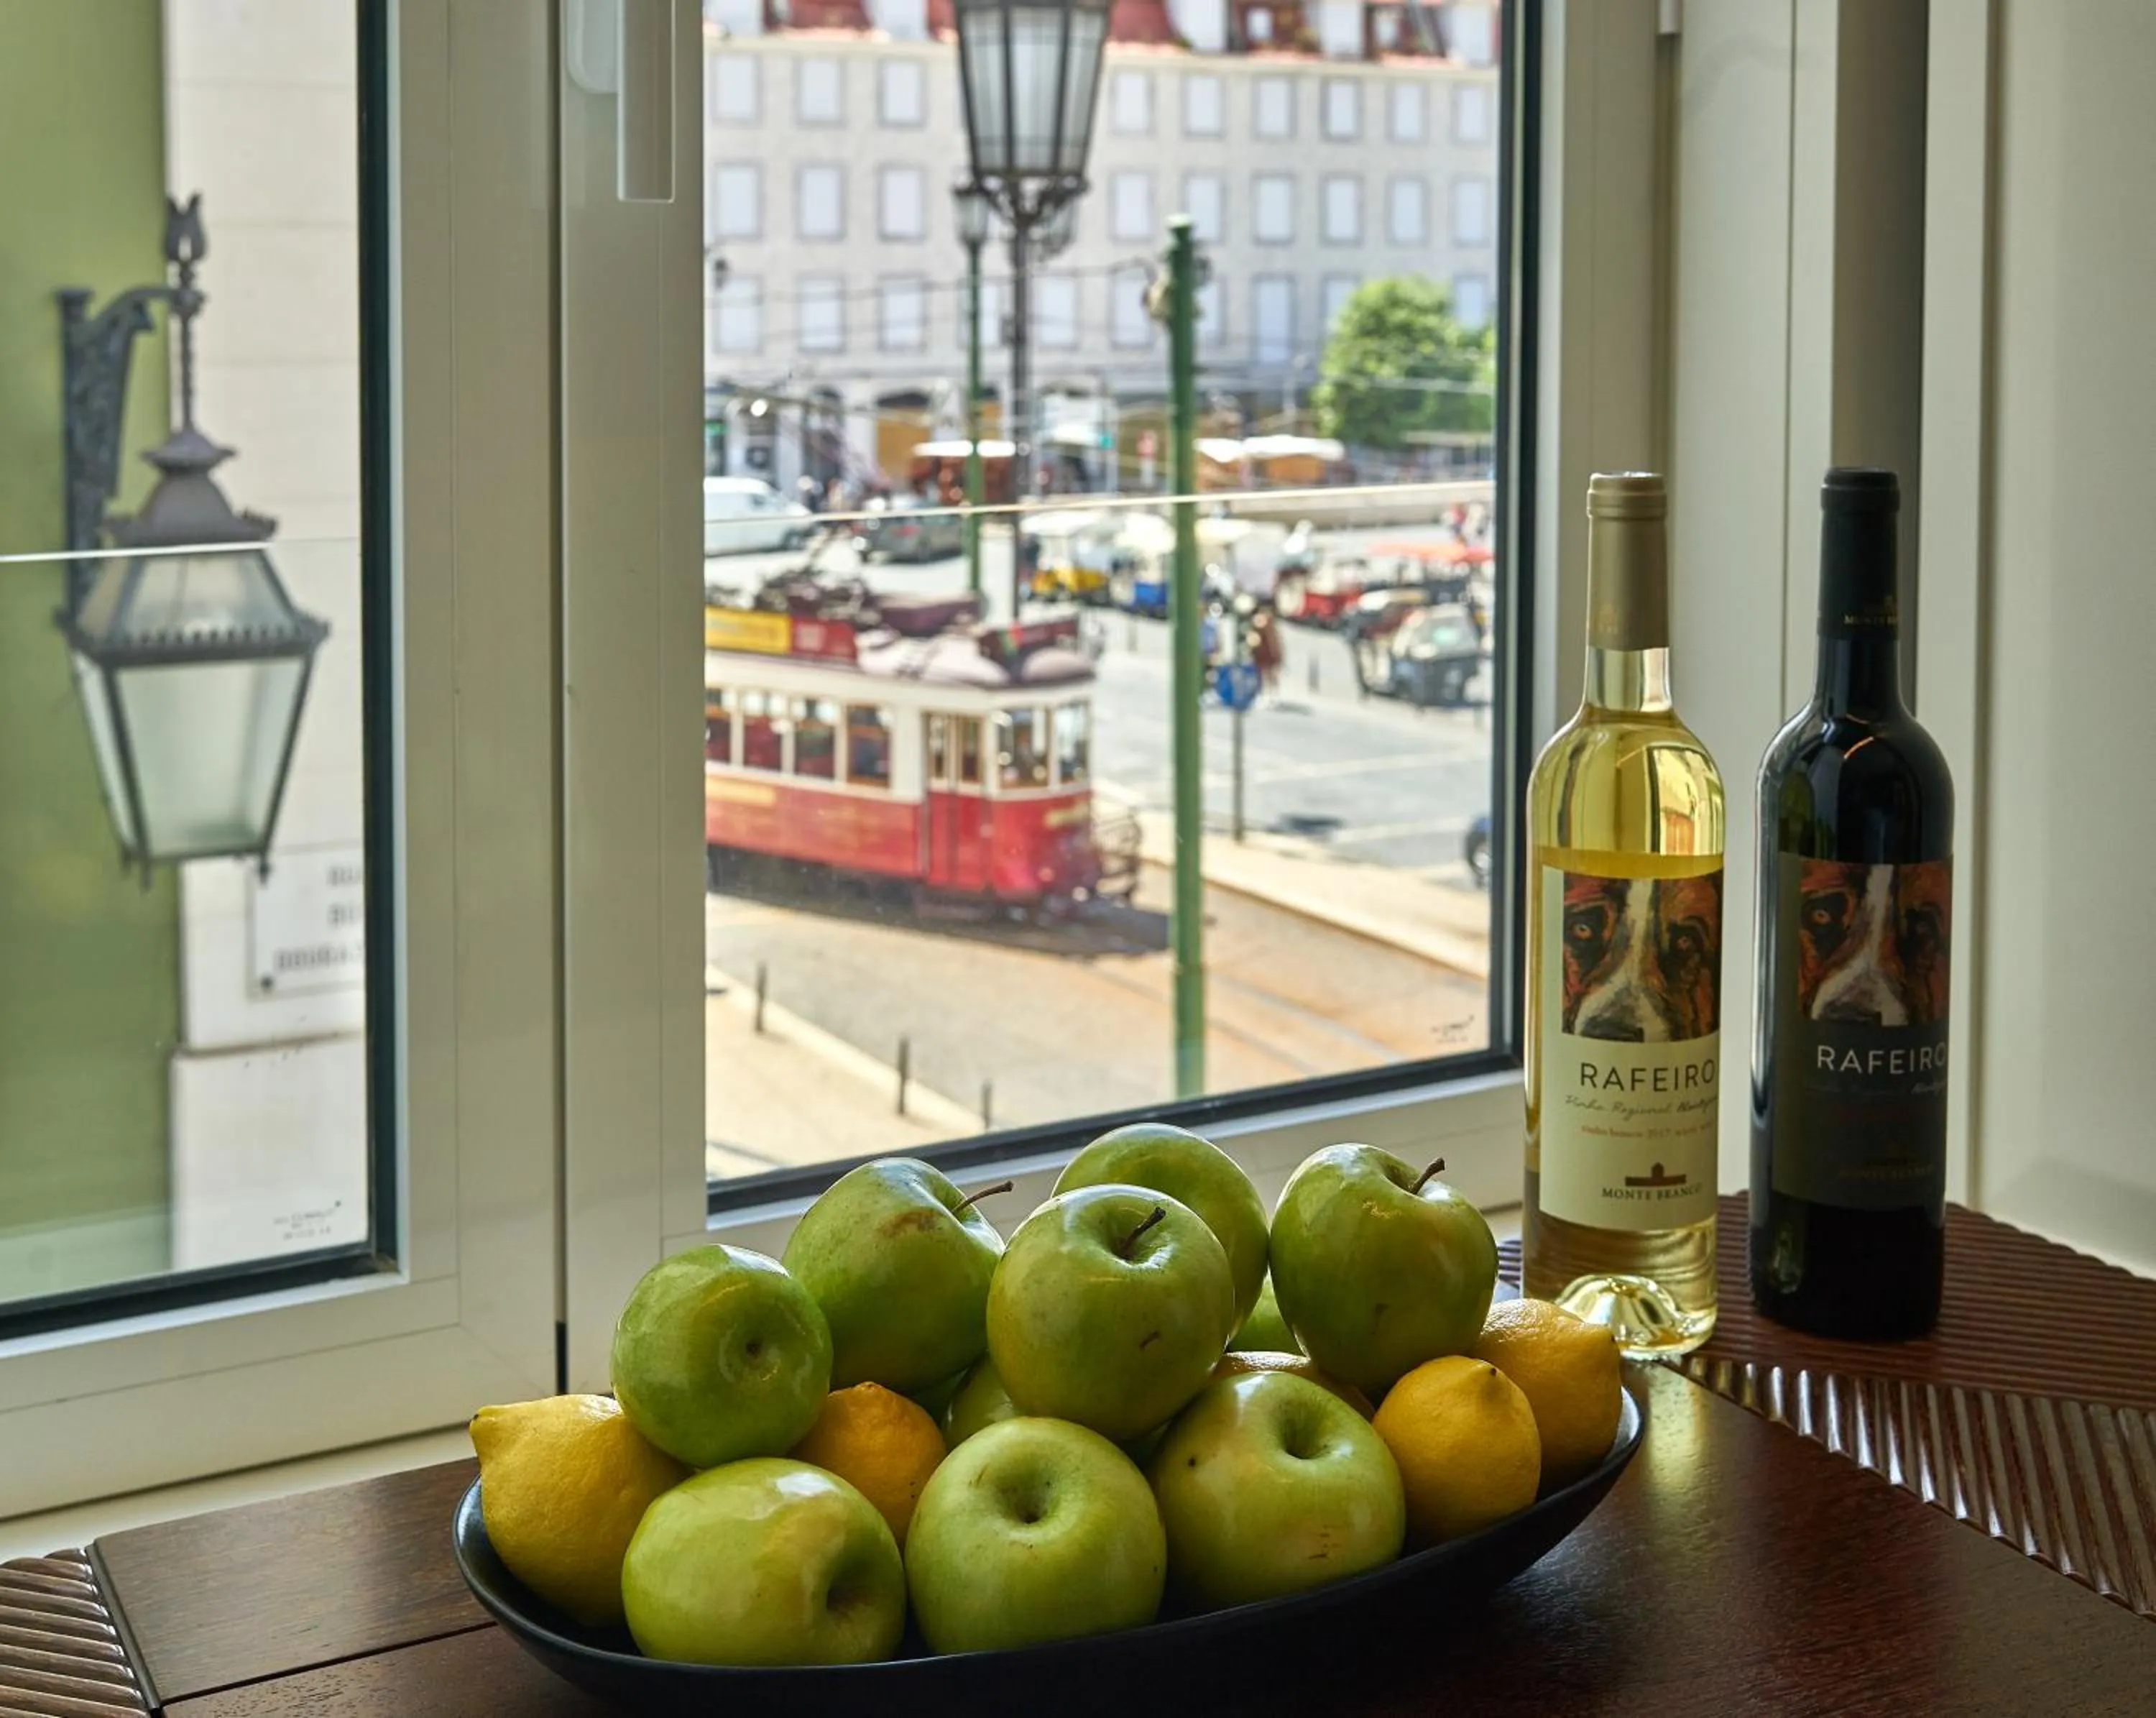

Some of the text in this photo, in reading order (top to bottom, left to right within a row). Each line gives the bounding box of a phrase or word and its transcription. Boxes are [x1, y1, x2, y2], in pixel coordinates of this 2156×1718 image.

[1818, 1042, 1946, 1075] RAFEIRO
[1580, 1059, 1715, 1092] RAFEIRO
[1602, 1188, 1651, 1200] MONTE
